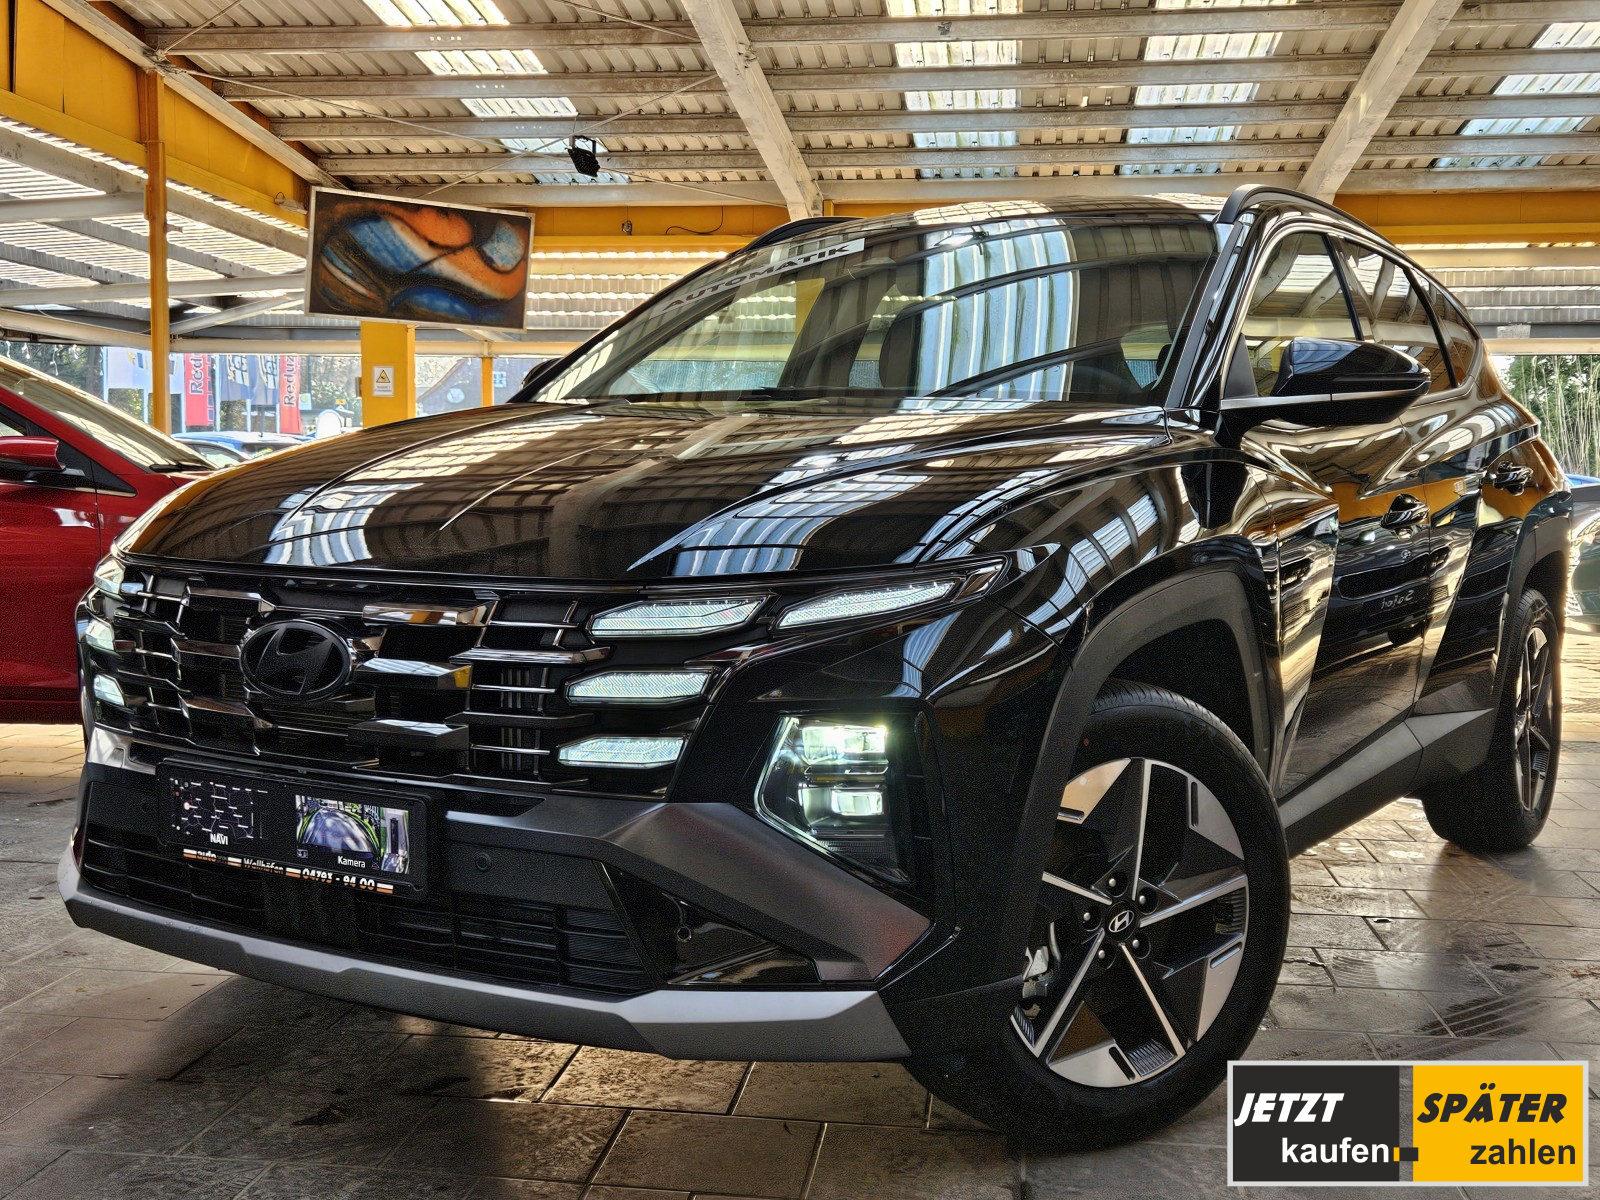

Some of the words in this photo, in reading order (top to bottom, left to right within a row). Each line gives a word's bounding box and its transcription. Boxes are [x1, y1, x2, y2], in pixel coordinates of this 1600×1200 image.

[662, 243, 850, 312] AUTOMATIK
[189, 353, 204, 395] Red
[210, 832, 229, 846] NAVI
[337, 855, 366, 868] Kamera
